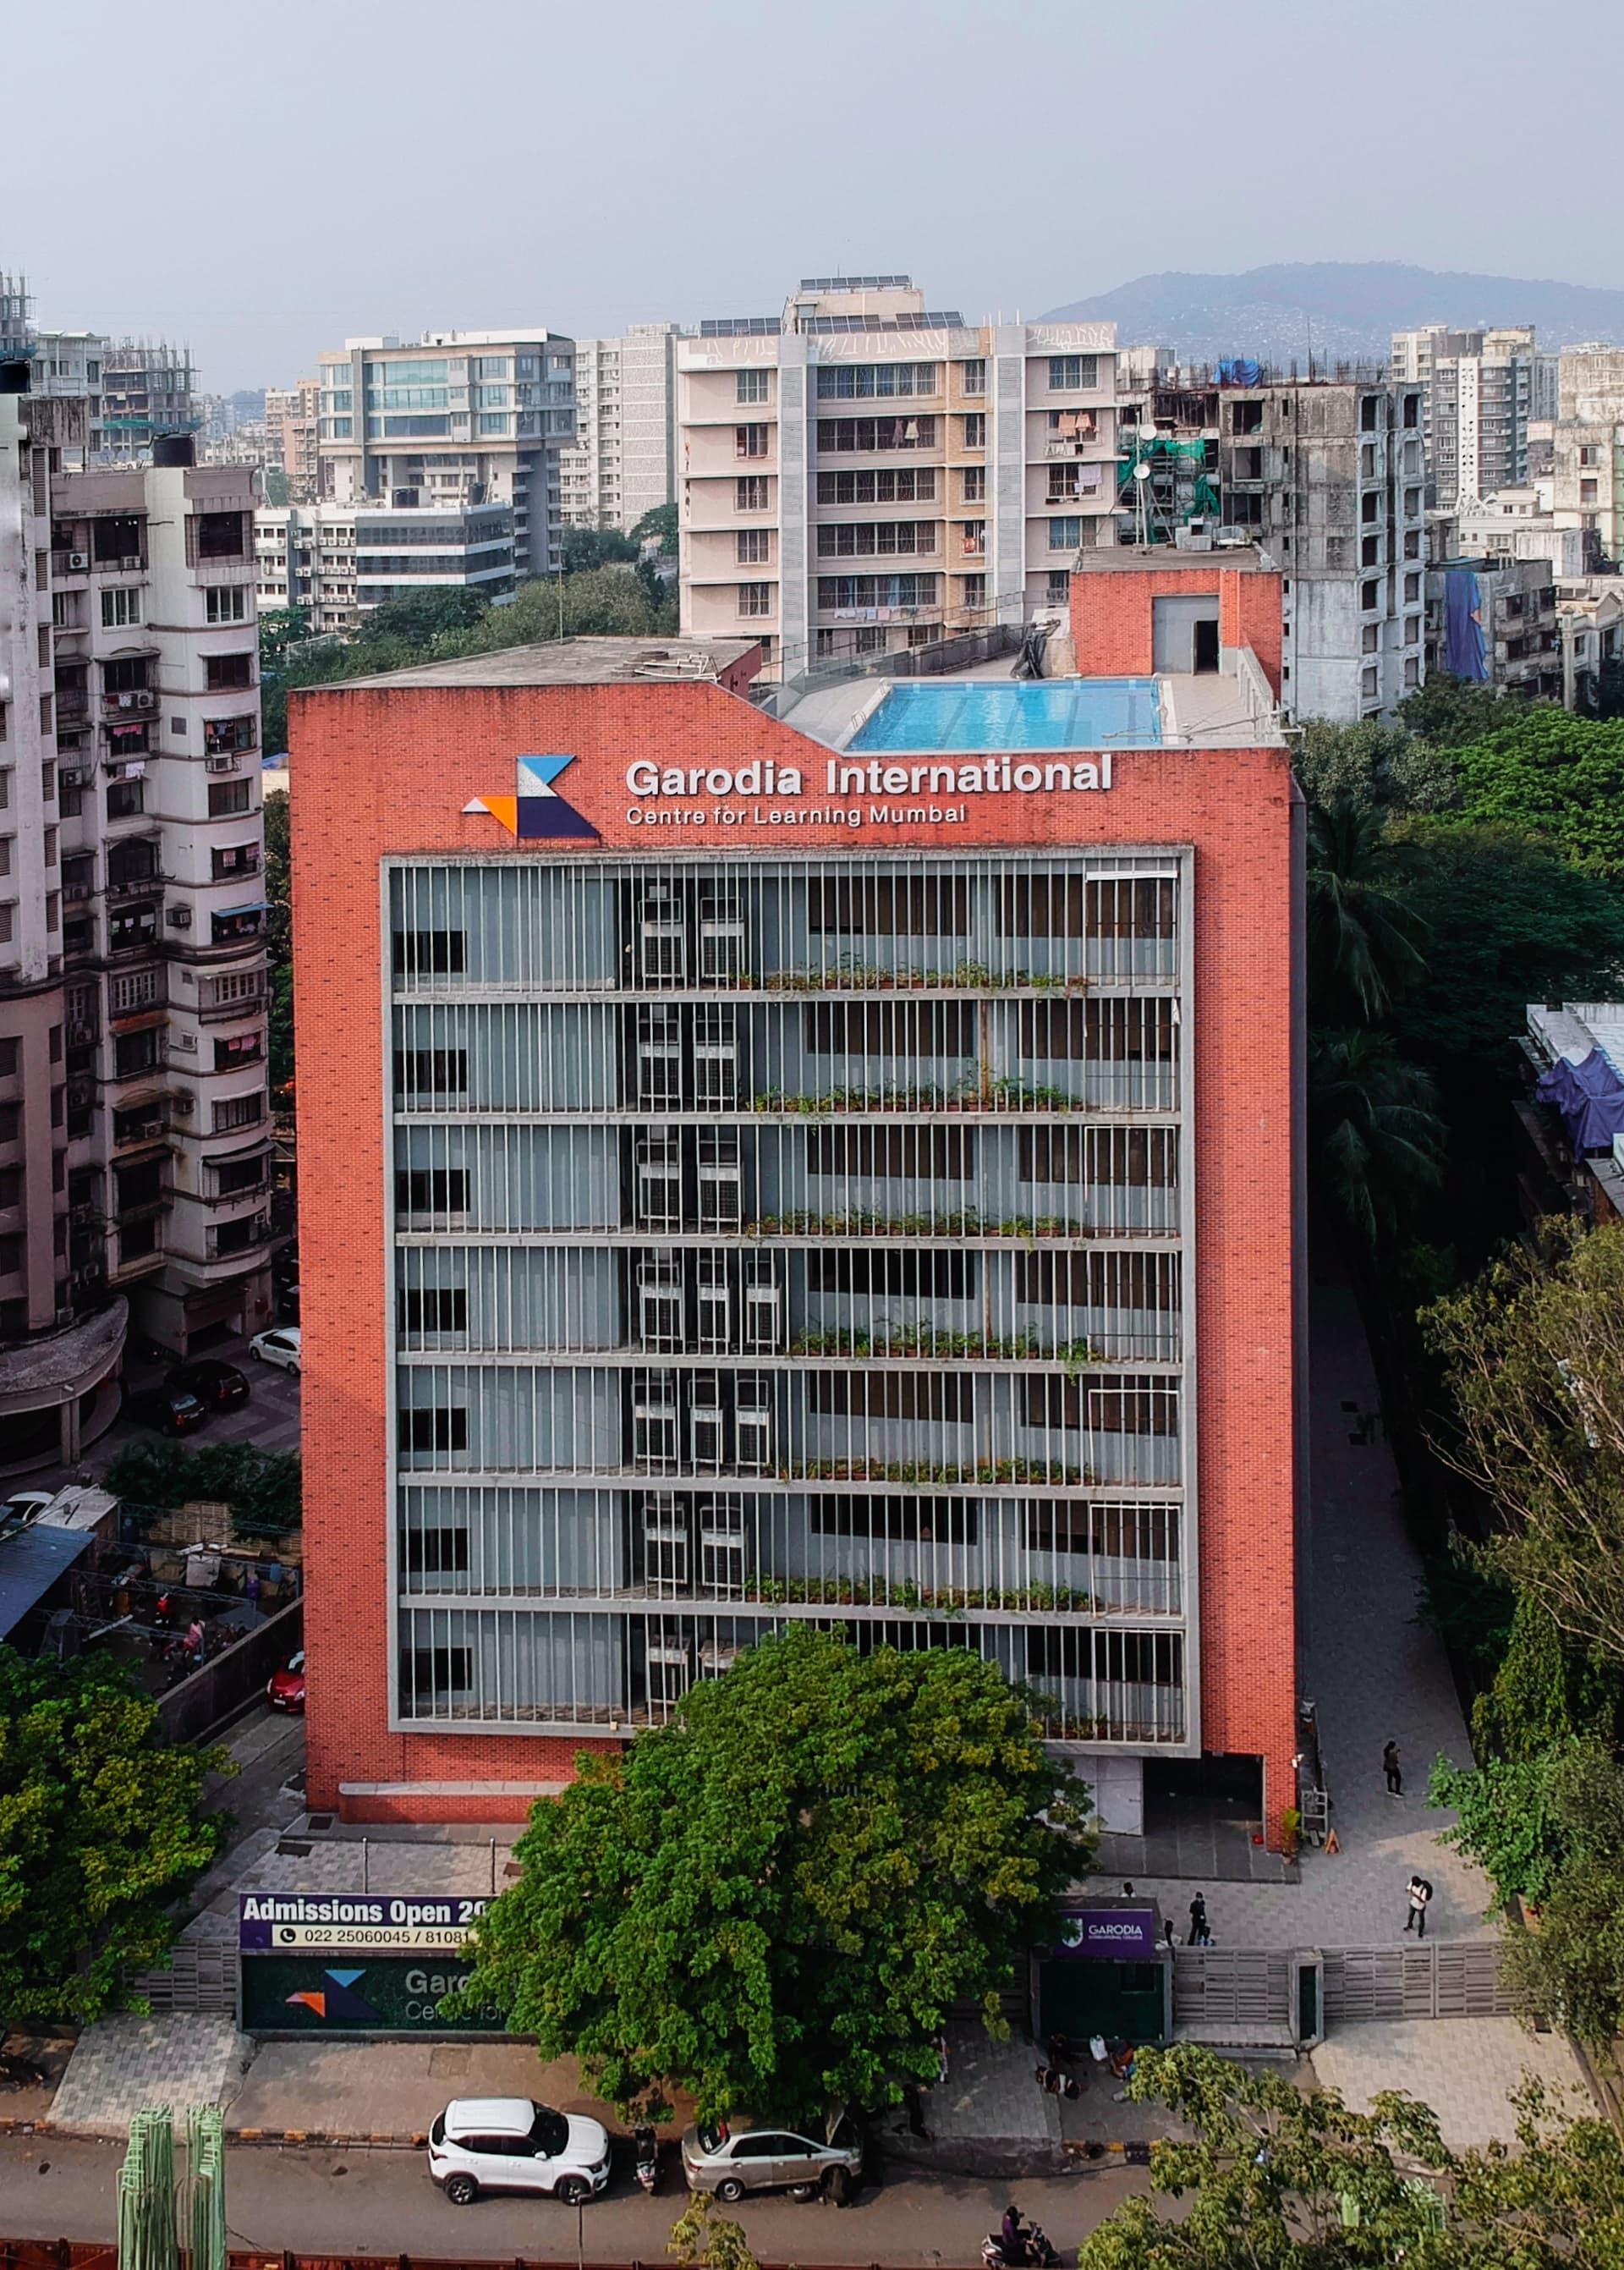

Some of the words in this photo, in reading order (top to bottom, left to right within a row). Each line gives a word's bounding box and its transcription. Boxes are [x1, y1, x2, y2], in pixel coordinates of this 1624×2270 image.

[626, 759, 802, 795] Garodia
[827, 753, 1111, 794] International
[626, 806, 705, 825] Centre
[713, 806, 747, 825] for
[754, 805, 861, 827] Learning
[870, 804, 965, 824] Mumbai
[243, 1897, 384, 1922] Admissions
[390, 1900, 451, 1926] Open
[458, 1900, 486, 1922] 20
[304, 1929, 332, 1943] 022
[337, 1930, 410, 1943] 25060045
[414, 1931, 421, 1943] /
[425, 1931, 469, 1943] 81081
[1088, 1924, 1143, 1936] GARODIA
